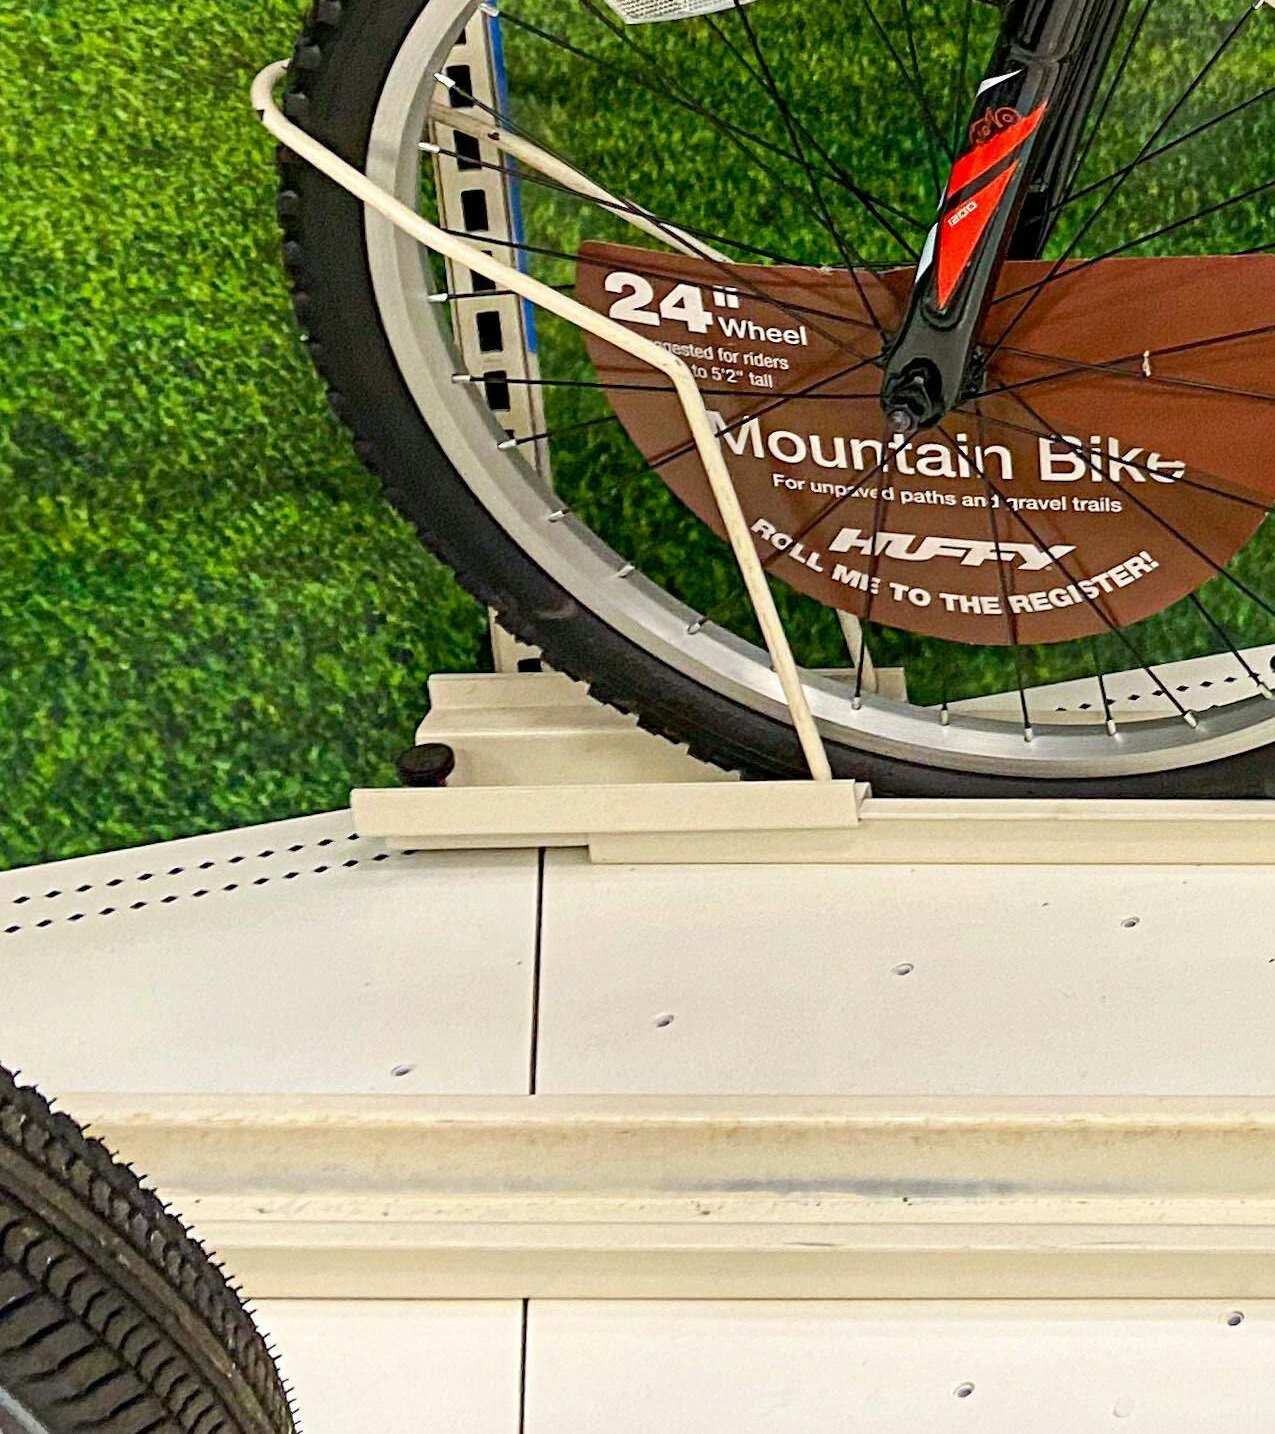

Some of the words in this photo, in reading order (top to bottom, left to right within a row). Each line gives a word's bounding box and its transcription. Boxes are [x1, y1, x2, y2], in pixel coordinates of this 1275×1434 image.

[604, 271, 740, 334] 24"
[717, 316, 808, 346] Wheel
[717, 347, 739, 364] for
[743, 350, 790, 370] riders
[748, 372, 774, 388] tall
[706, 410, 1012, 481] Mountain
[1038, 434, 1186, 484] Bike
[772, 474, 805, 490] For
[810, 482, 894, 502] unpaved
[900, 488, 956, 507] paths
[1006, 495, 1067, 513] gravel
[1072, 497, 1122, 513] trails
[750, 518, 824, 572] ROLL
[831, 564, 879, 595] ME
[889, 582, 931, 607] TO
[939, 592, 1002, 615] THE
[1007, 550, 1160, 615] REGISTER!
[828, 527, 1076, 571] HUFFY
